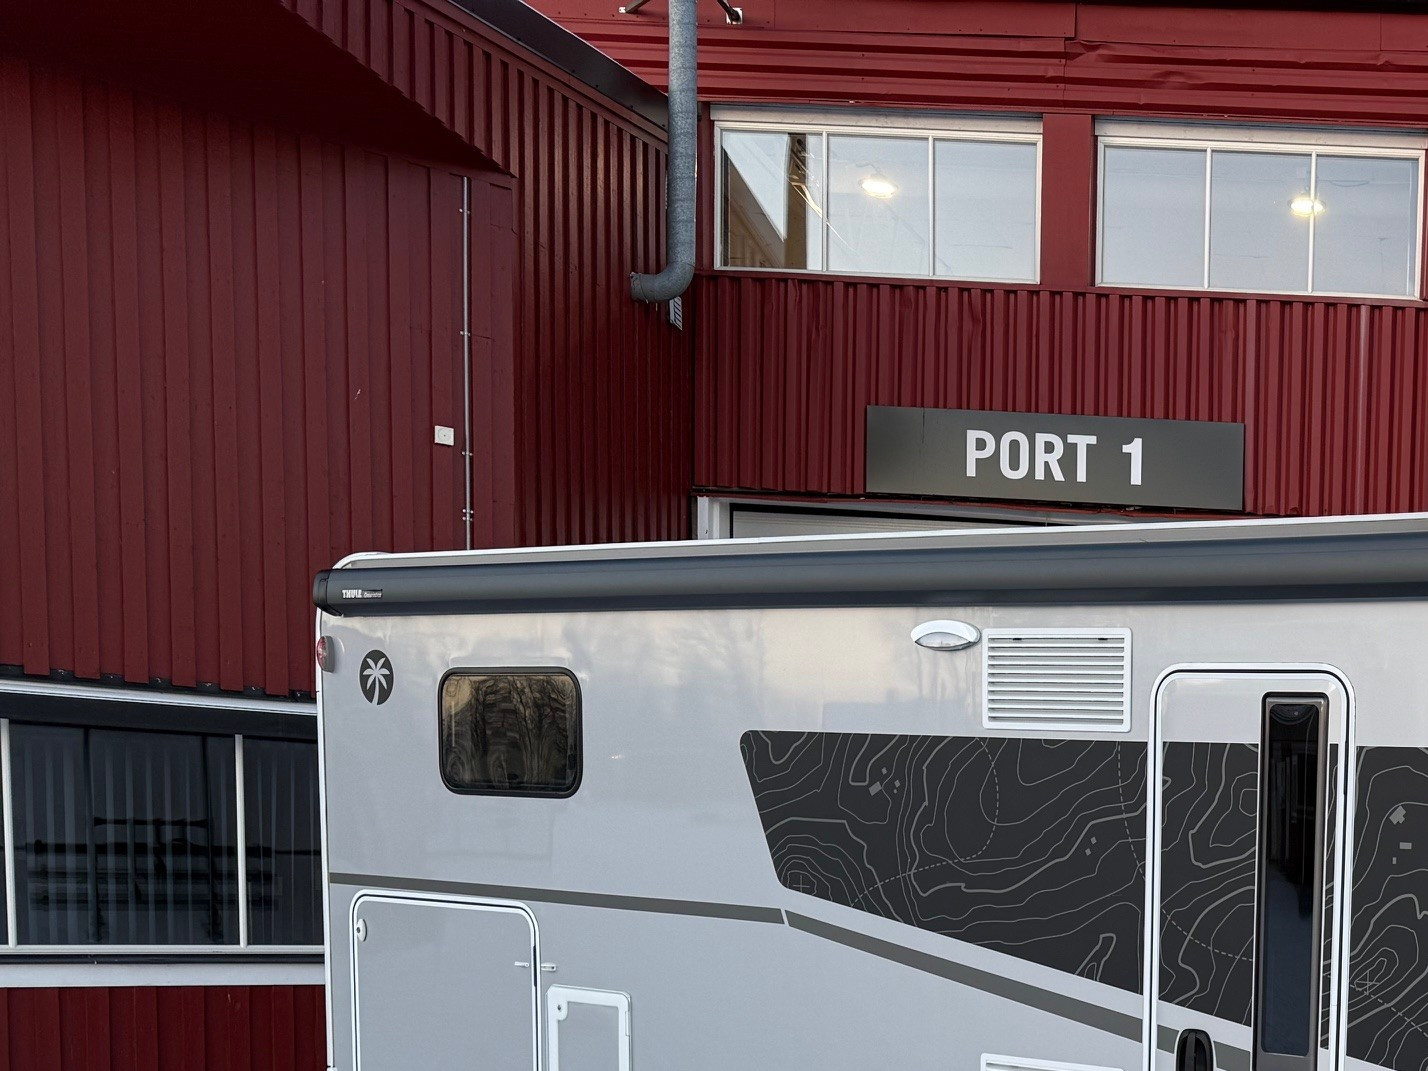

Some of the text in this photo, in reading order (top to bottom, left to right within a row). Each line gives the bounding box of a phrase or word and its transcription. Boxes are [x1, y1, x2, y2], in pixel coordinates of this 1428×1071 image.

[966, 429, 1143, 486] PORT 1
[342, 588, 362, 598] THULE
